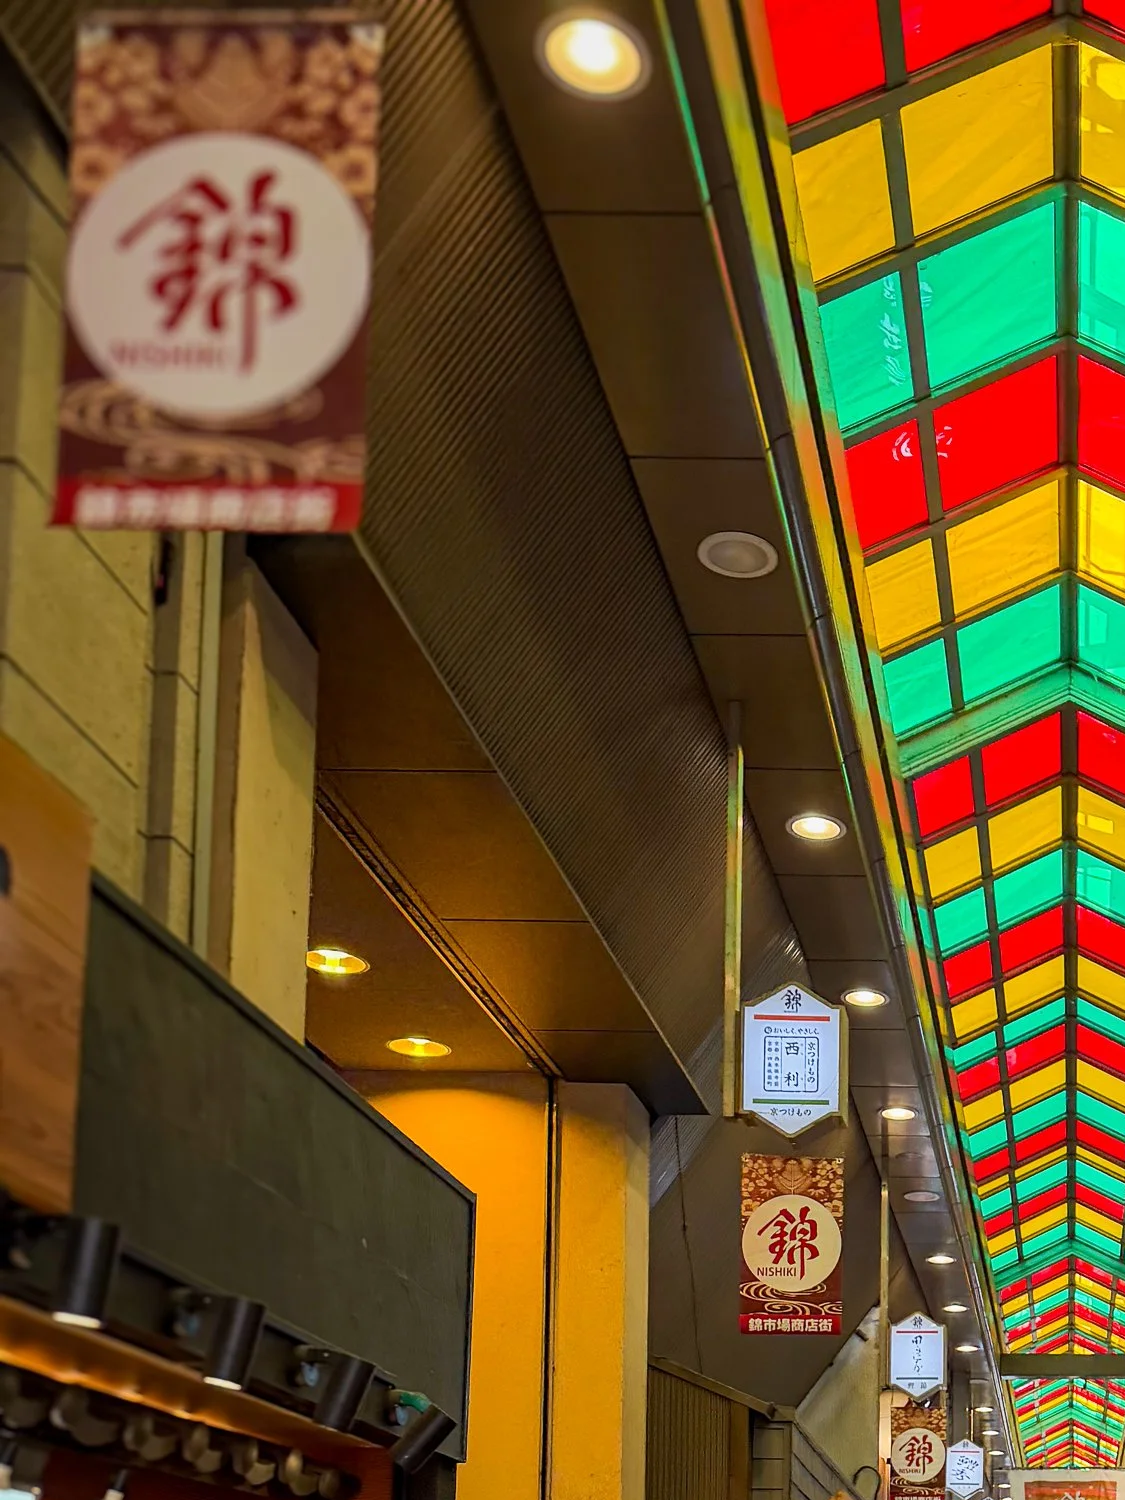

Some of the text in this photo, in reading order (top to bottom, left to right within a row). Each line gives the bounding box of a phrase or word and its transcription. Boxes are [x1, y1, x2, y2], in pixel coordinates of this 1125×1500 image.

[117, 170, 300, 376] 錦
[781, 989, 802, 1013] 錦
[784, 1041, 800, 1087] 西利
[807, 1042, 816, 1083] 京つけもの
[770, 1107, 812, 1117] 京つけもの
[757, 1206, 820, 1280] 錦
[757, 1267, 797, 1277] NISHIKI
[748, 1318, 833, 1333] 錦市場商店街
[899, 1434, 934, 1475] 錦
